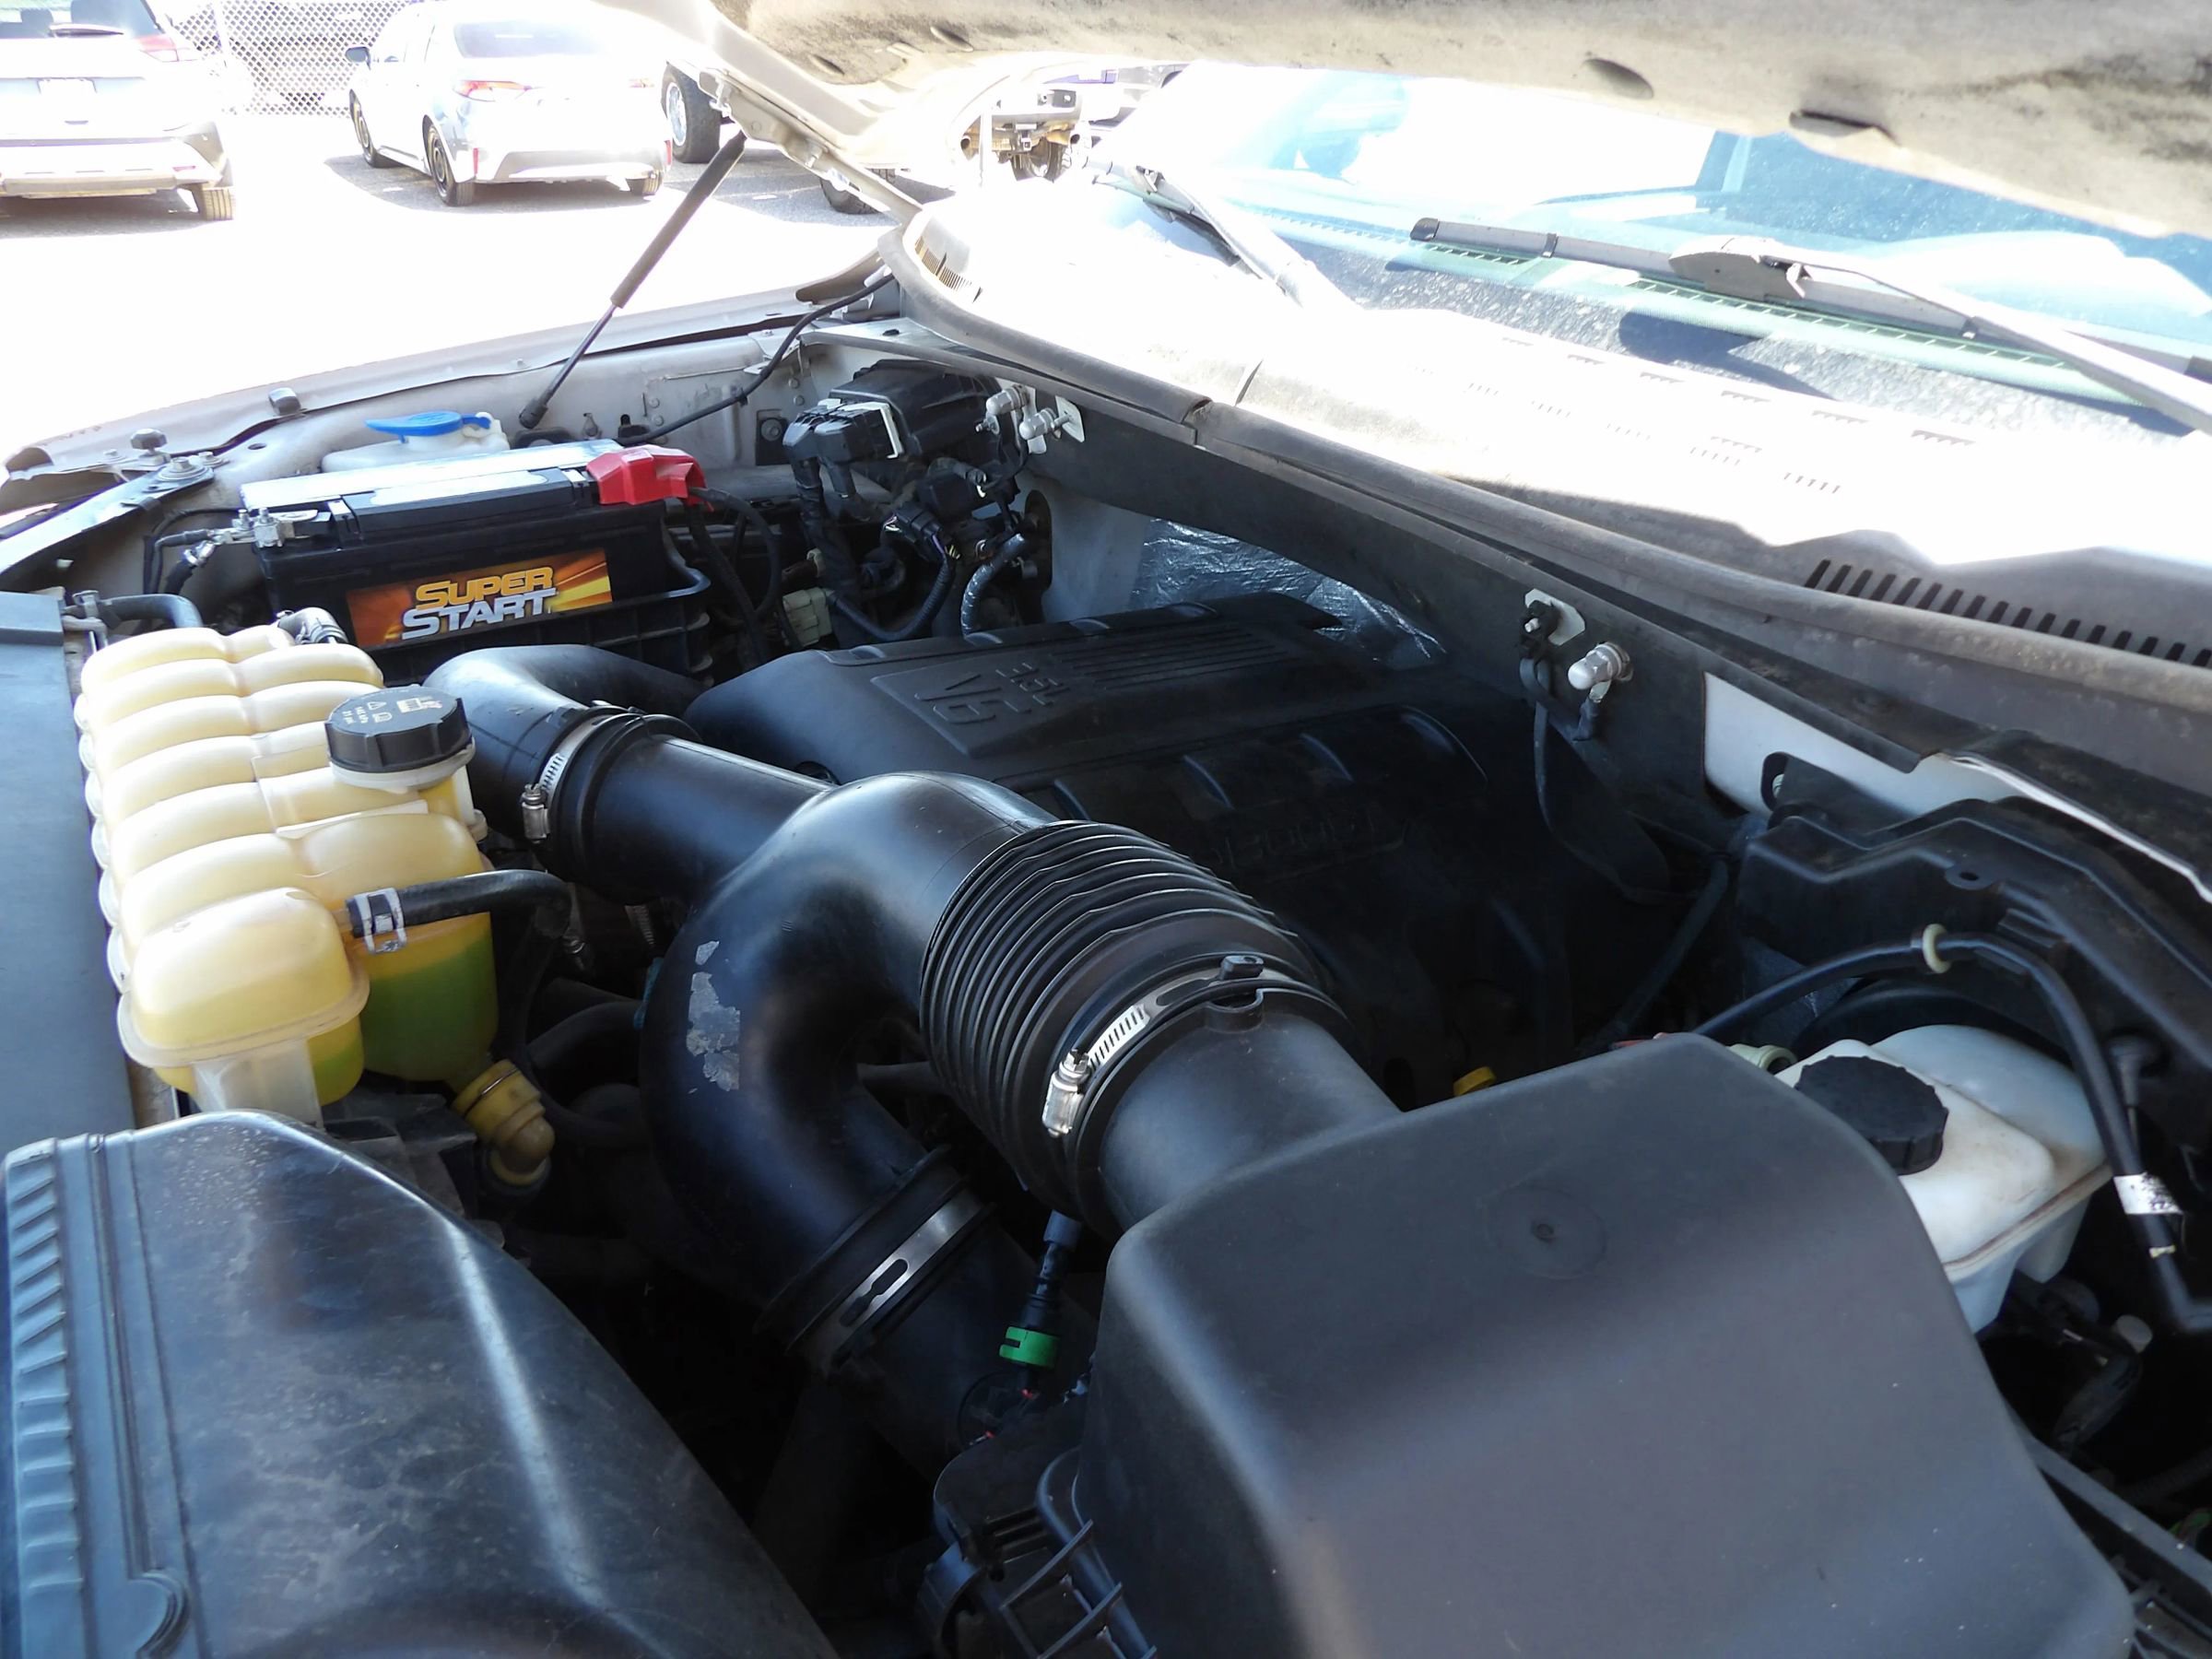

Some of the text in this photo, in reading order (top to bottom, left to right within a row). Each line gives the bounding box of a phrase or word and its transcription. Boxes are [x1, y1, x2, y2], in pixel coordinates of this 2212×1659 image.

[416, 566, 554, 610] SUPER
[401, 587, 558, 641] START
[913, 674, 1032, 725] V6
